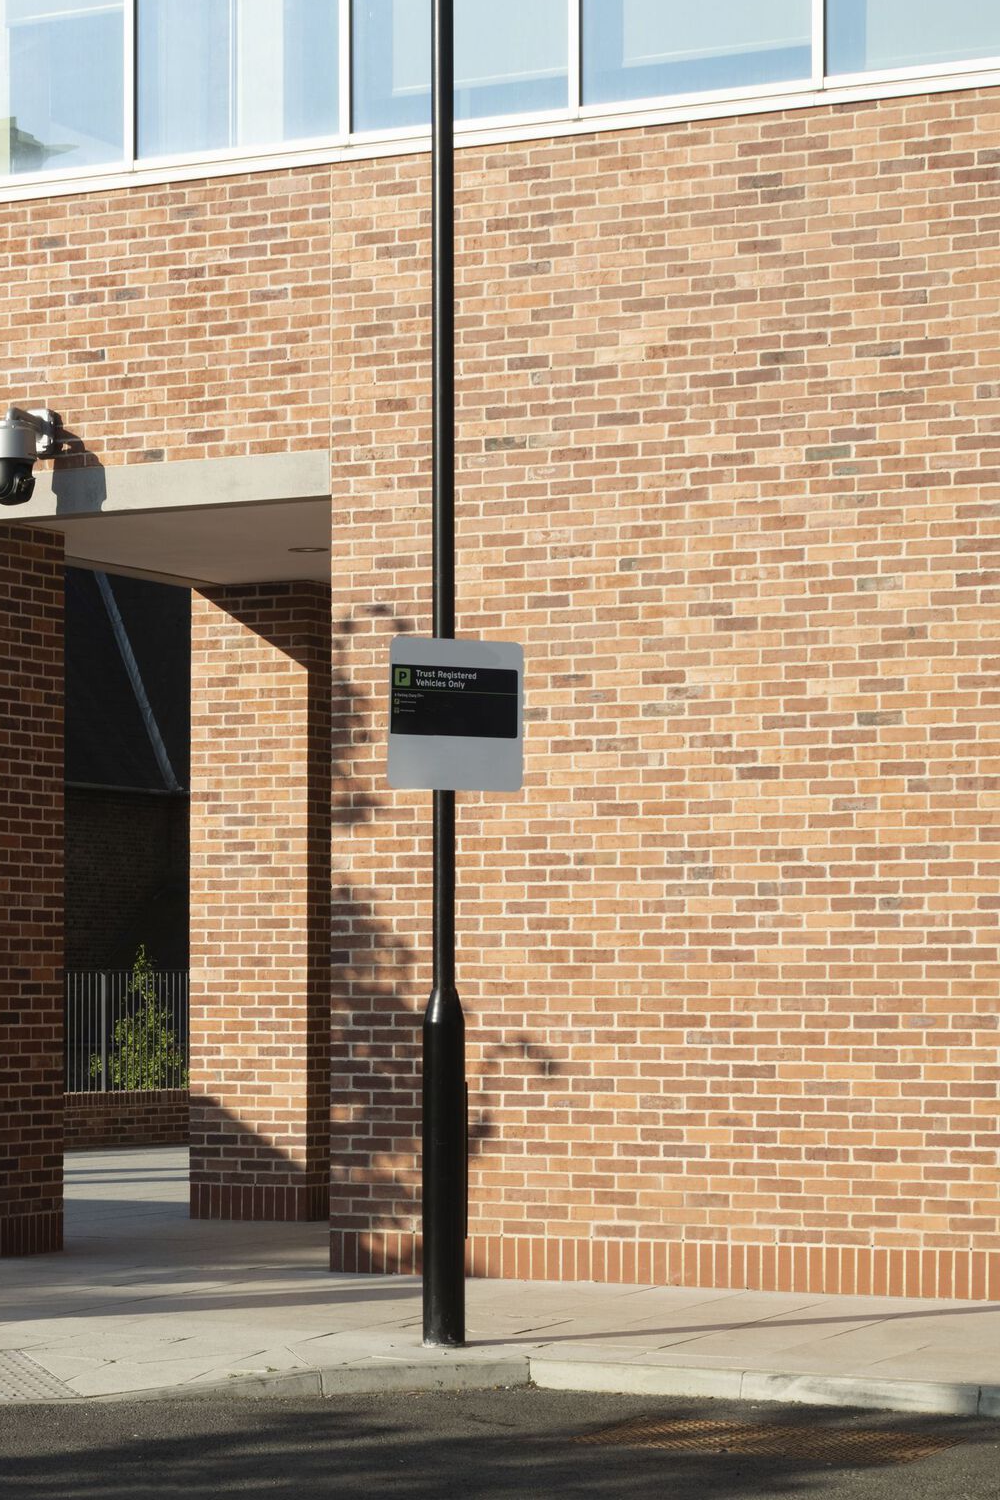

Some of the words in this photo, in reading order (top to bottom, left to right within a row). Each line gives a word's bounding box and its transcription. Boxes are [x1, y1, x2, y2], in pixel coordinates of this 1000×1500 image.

[399, 671, 407, 683] P
[416, 669, 435, 678] Trust
[438, 670, 477, 680] Registered
[416, 679, 446, 687] Vehicles
[448, 680, 466, 689] Only
